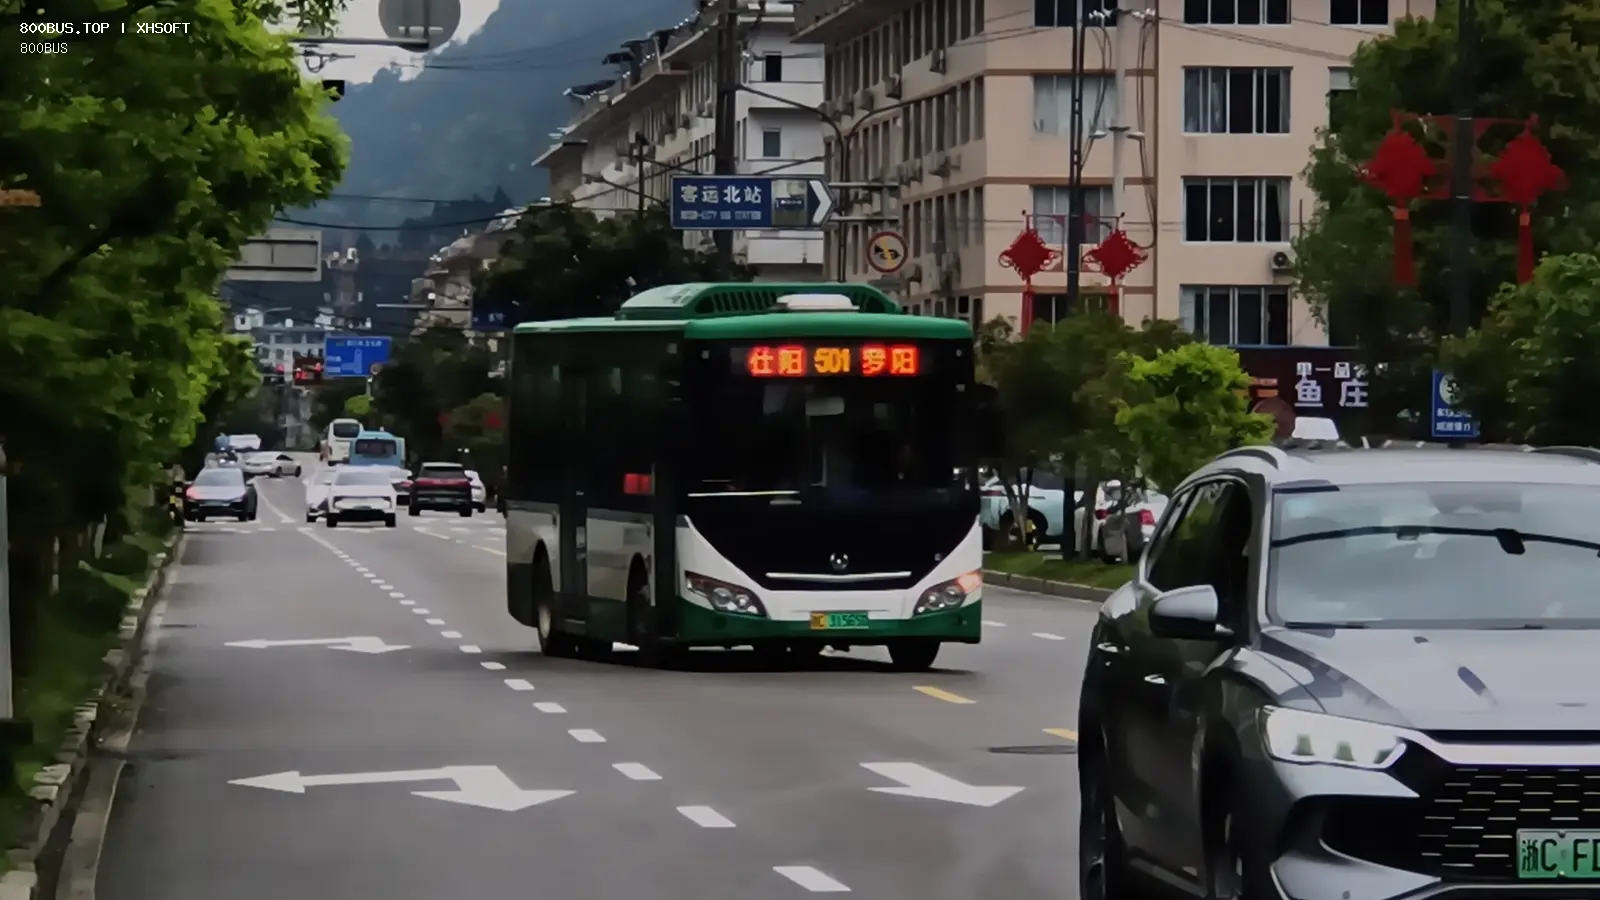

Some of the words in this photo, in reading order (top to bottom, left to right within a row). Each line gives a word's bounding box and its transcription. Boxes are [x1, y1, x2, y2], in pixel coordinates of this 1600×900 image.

[680, 184, 762, 204] 客运北站
[750, 346, 804, 375] 仕阳
[814, 347, 850, 373] 501
[862, 346, 917, 375] 罗阳
[1293, 376, 1370, 408] 鱼庄
